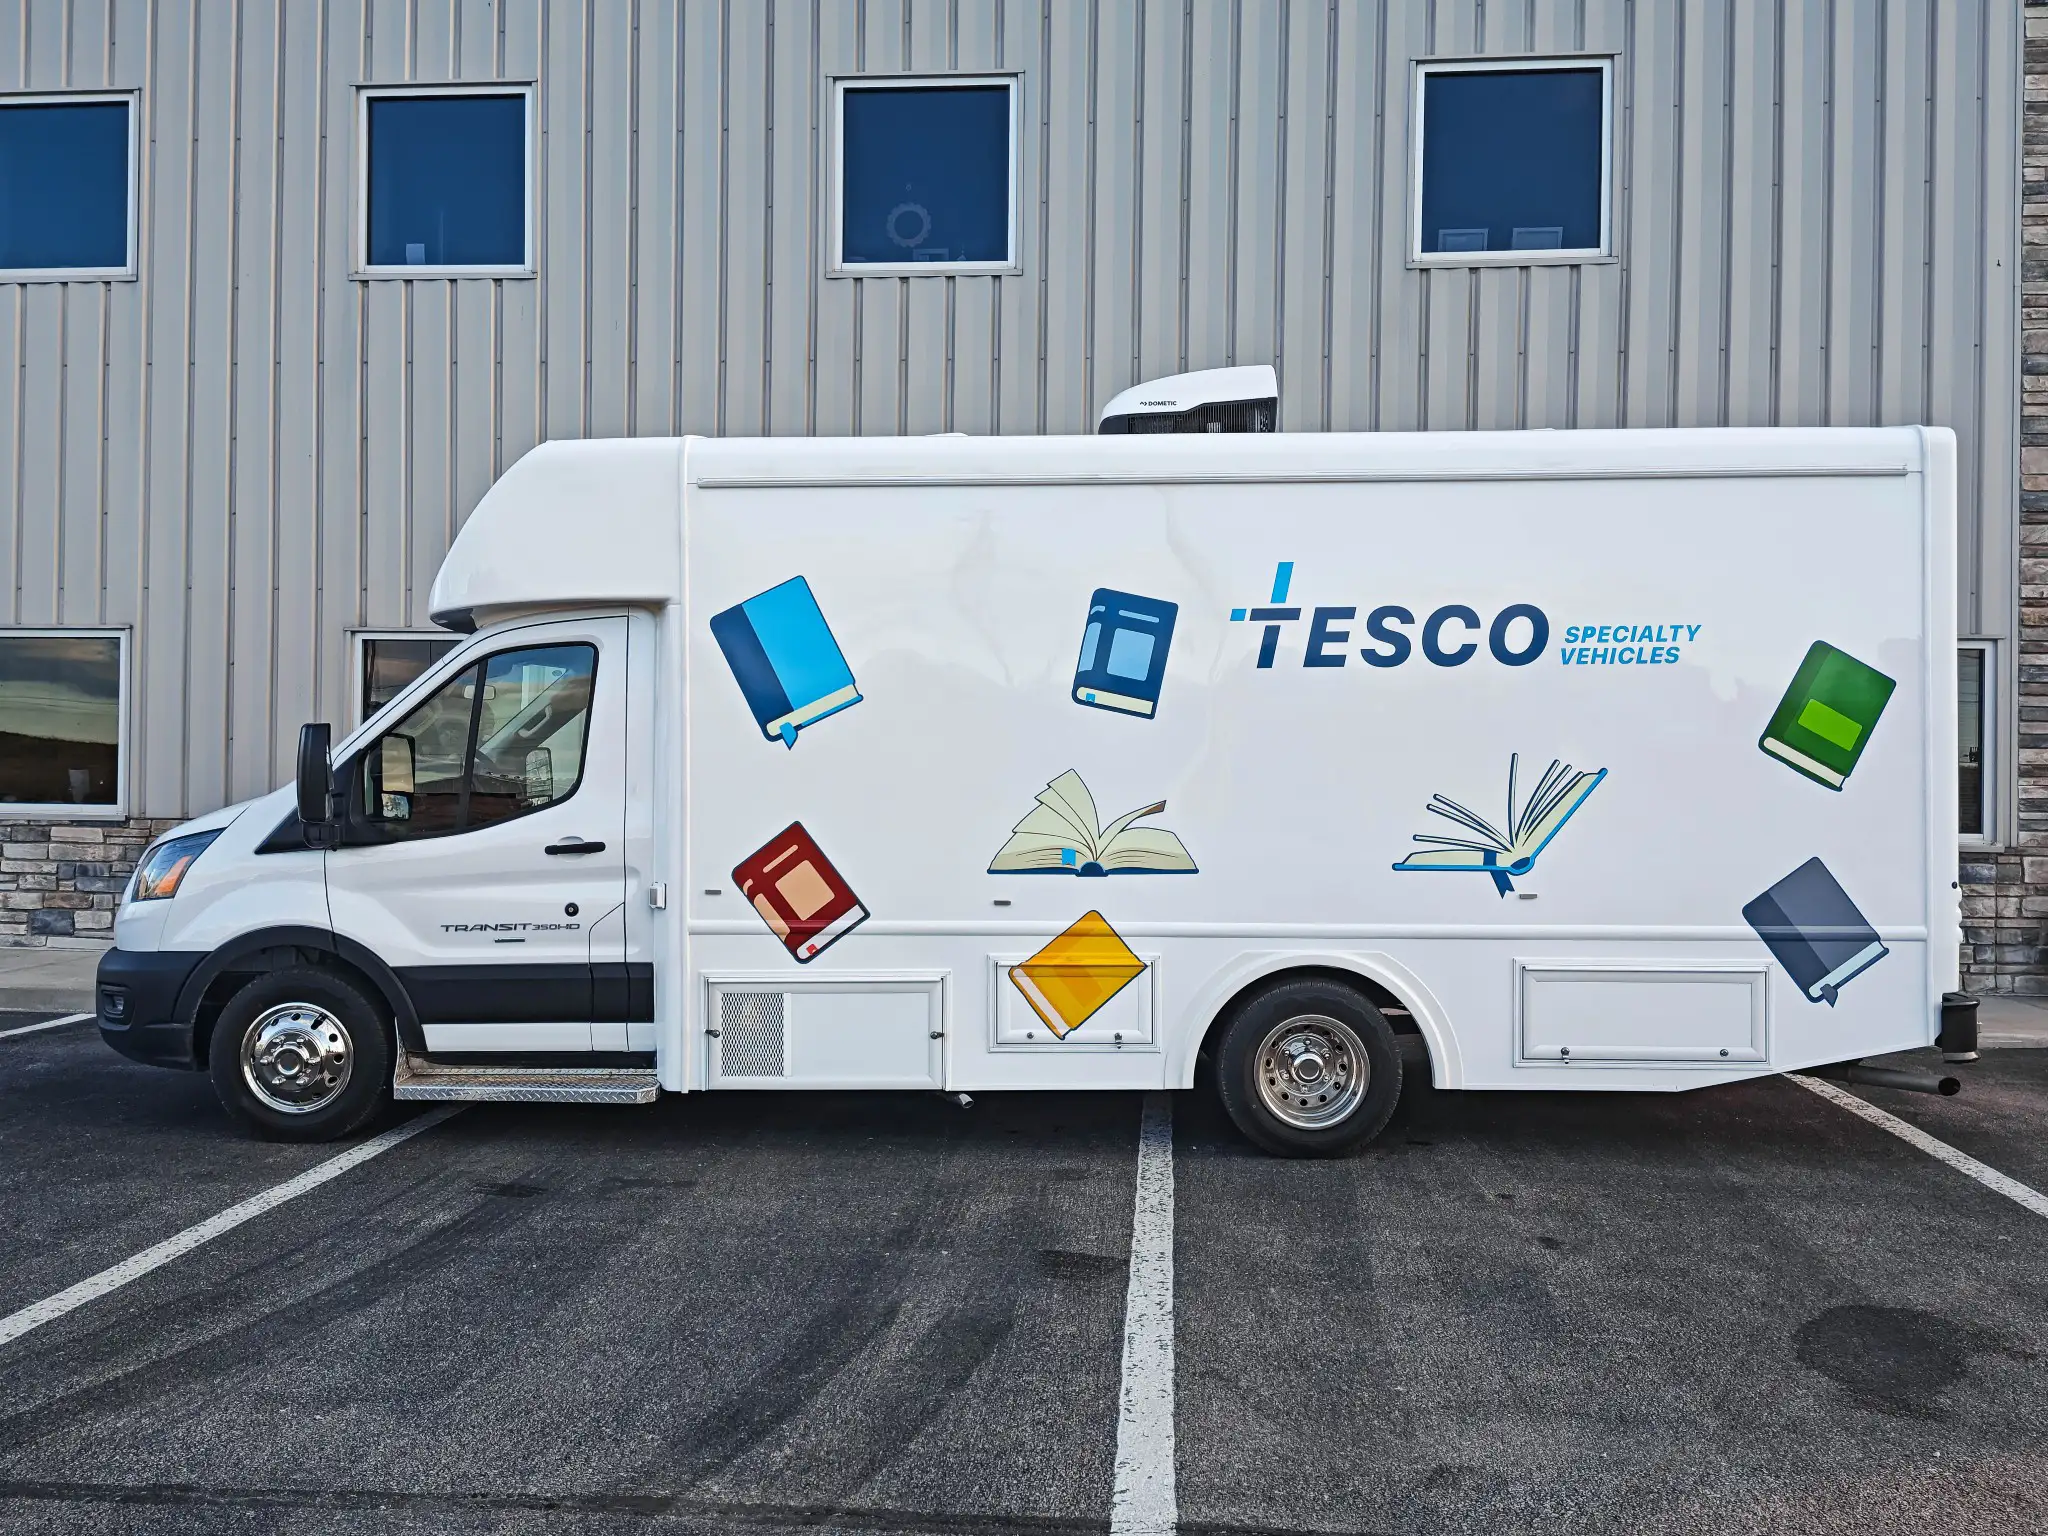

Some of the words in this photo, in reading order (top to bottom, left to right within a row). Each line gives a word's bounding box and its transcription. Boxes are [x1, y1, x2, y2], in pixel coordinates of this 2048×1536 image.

[1230, 562, 1550, 668] TESCO
[1564, 624, 1703, 643] SPECIALTY
[1560, 646, 1681, 666] VEHICLES
